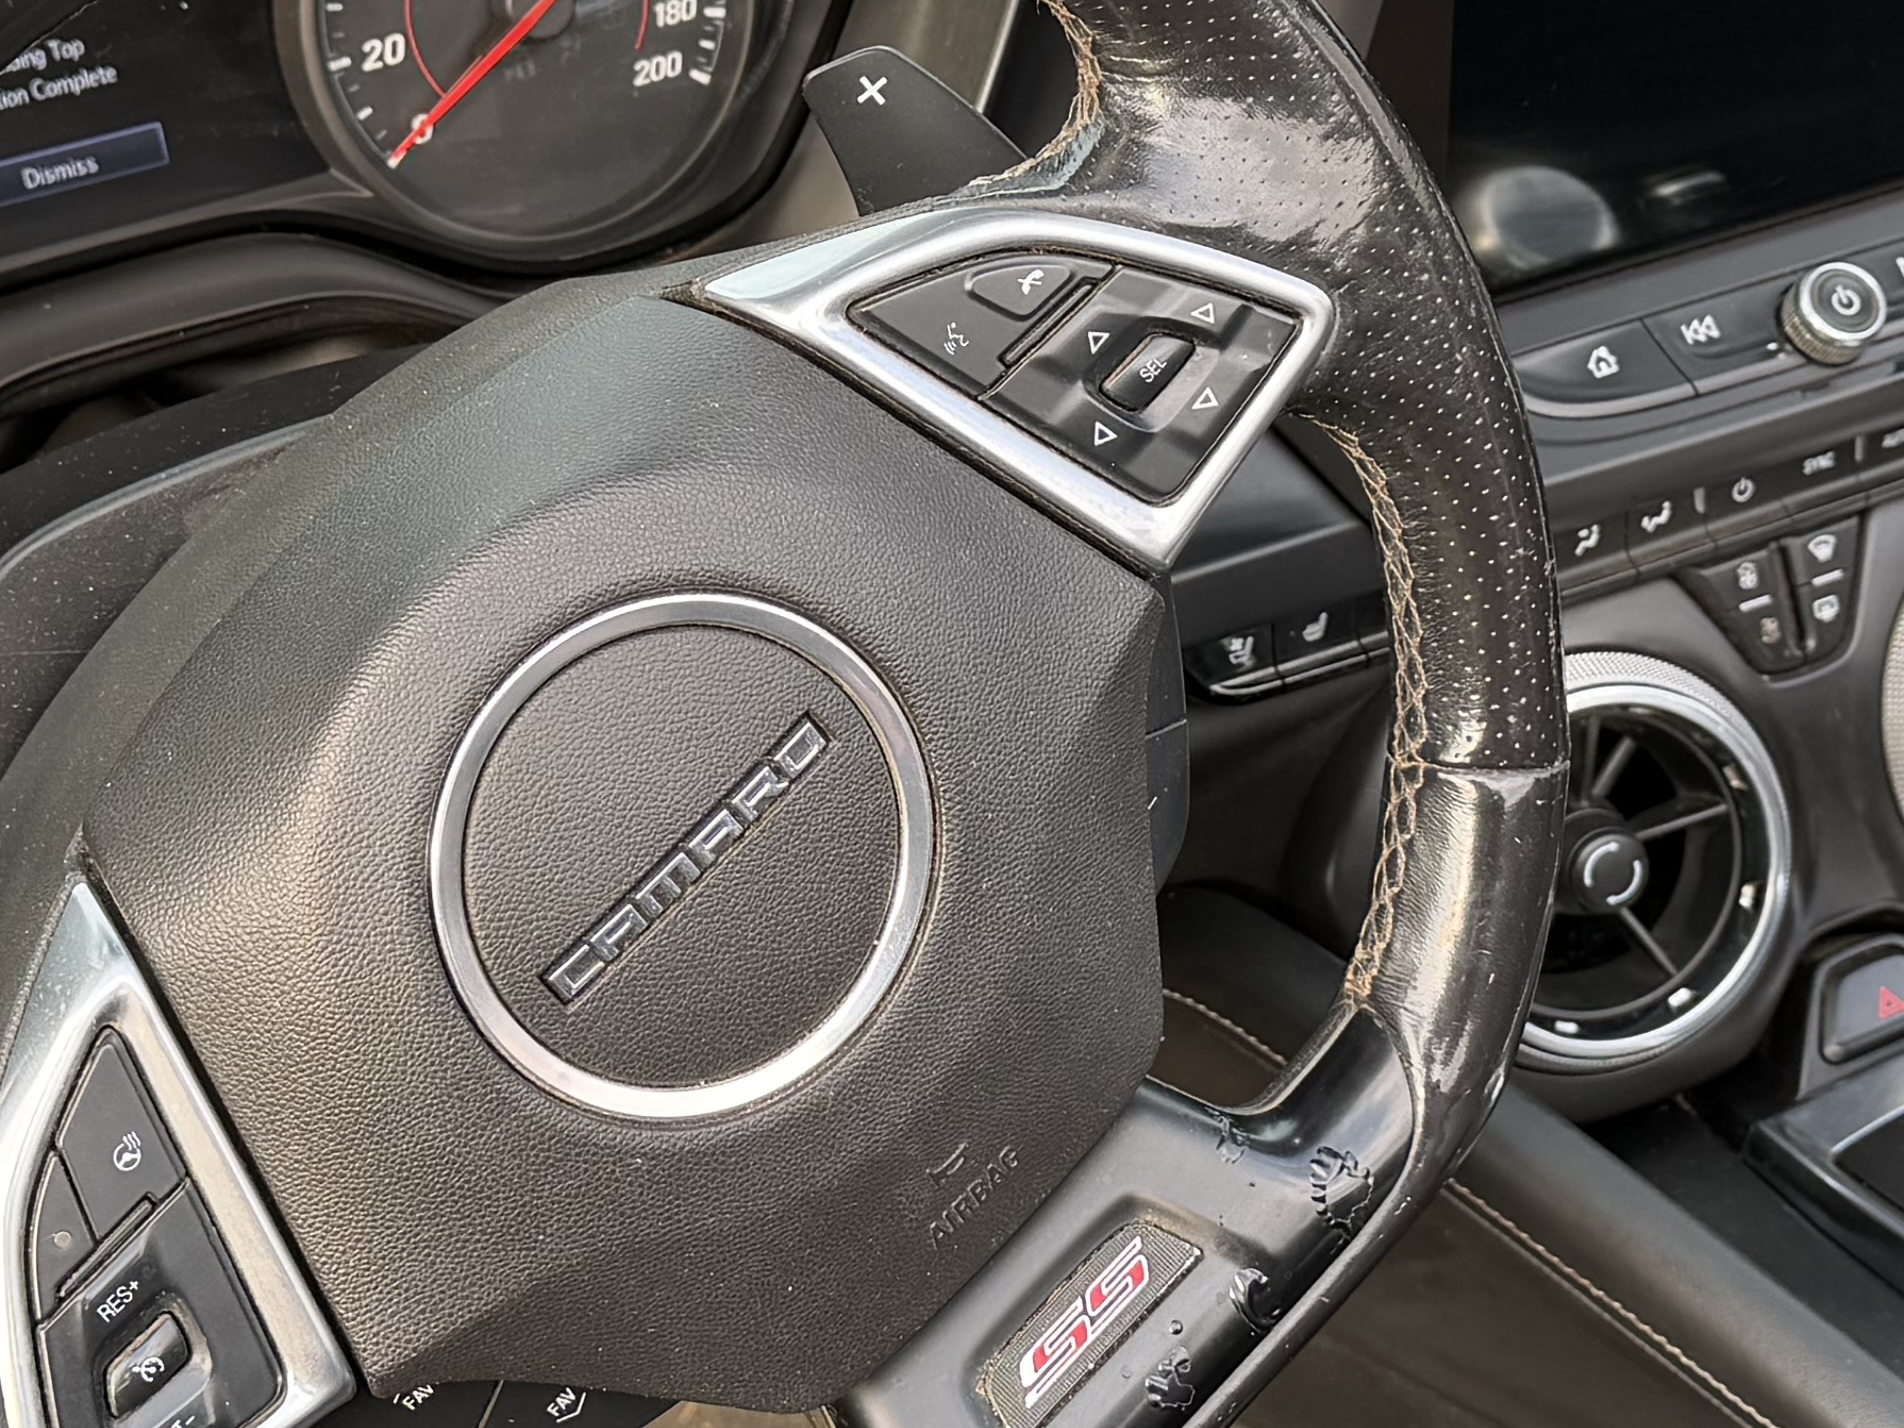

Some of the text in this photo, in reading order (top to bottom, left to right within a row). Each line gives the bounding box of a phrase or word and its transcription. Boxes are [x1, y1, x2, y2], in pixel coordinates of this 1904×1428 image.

[46, 38, 85, 61] Top
[361, 32, 407, 73] 20
[30, 66, 118, 101] Complete
[633, 50, 683, 87] 200
[21, 156, 99, 189] Dismiss
[1139, 356, 1168, 384] SEL
[546, 717, 830, 1002] CAMARO
[929, 1143, 1023, 1250] AIRBAG
[1018, 1234, 1150, 1410] SS
[402, 1383, 435, 1411] FAV
[546, 1386, 578, 1417] FAV
